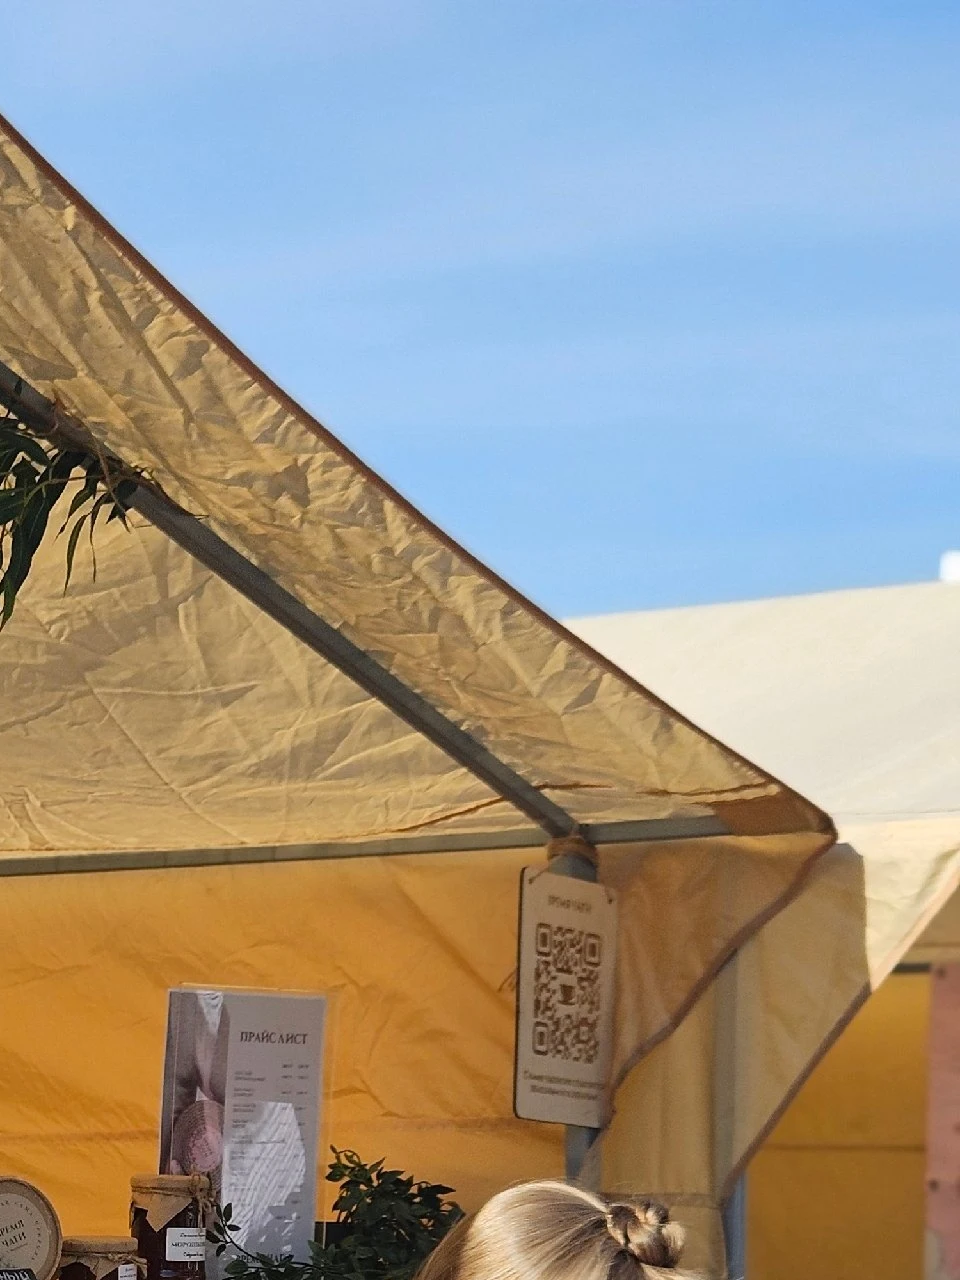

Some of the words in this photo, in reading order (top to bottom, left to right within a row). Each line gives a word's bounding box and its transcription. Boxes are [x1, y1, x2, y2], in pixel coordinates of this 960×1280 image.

[240, 1030, 276, 1044] ПРАЙС
[277, 1033, 308, 1045] ЛИСТ
[1, 1231, 27, 1247] ЧАГИ
